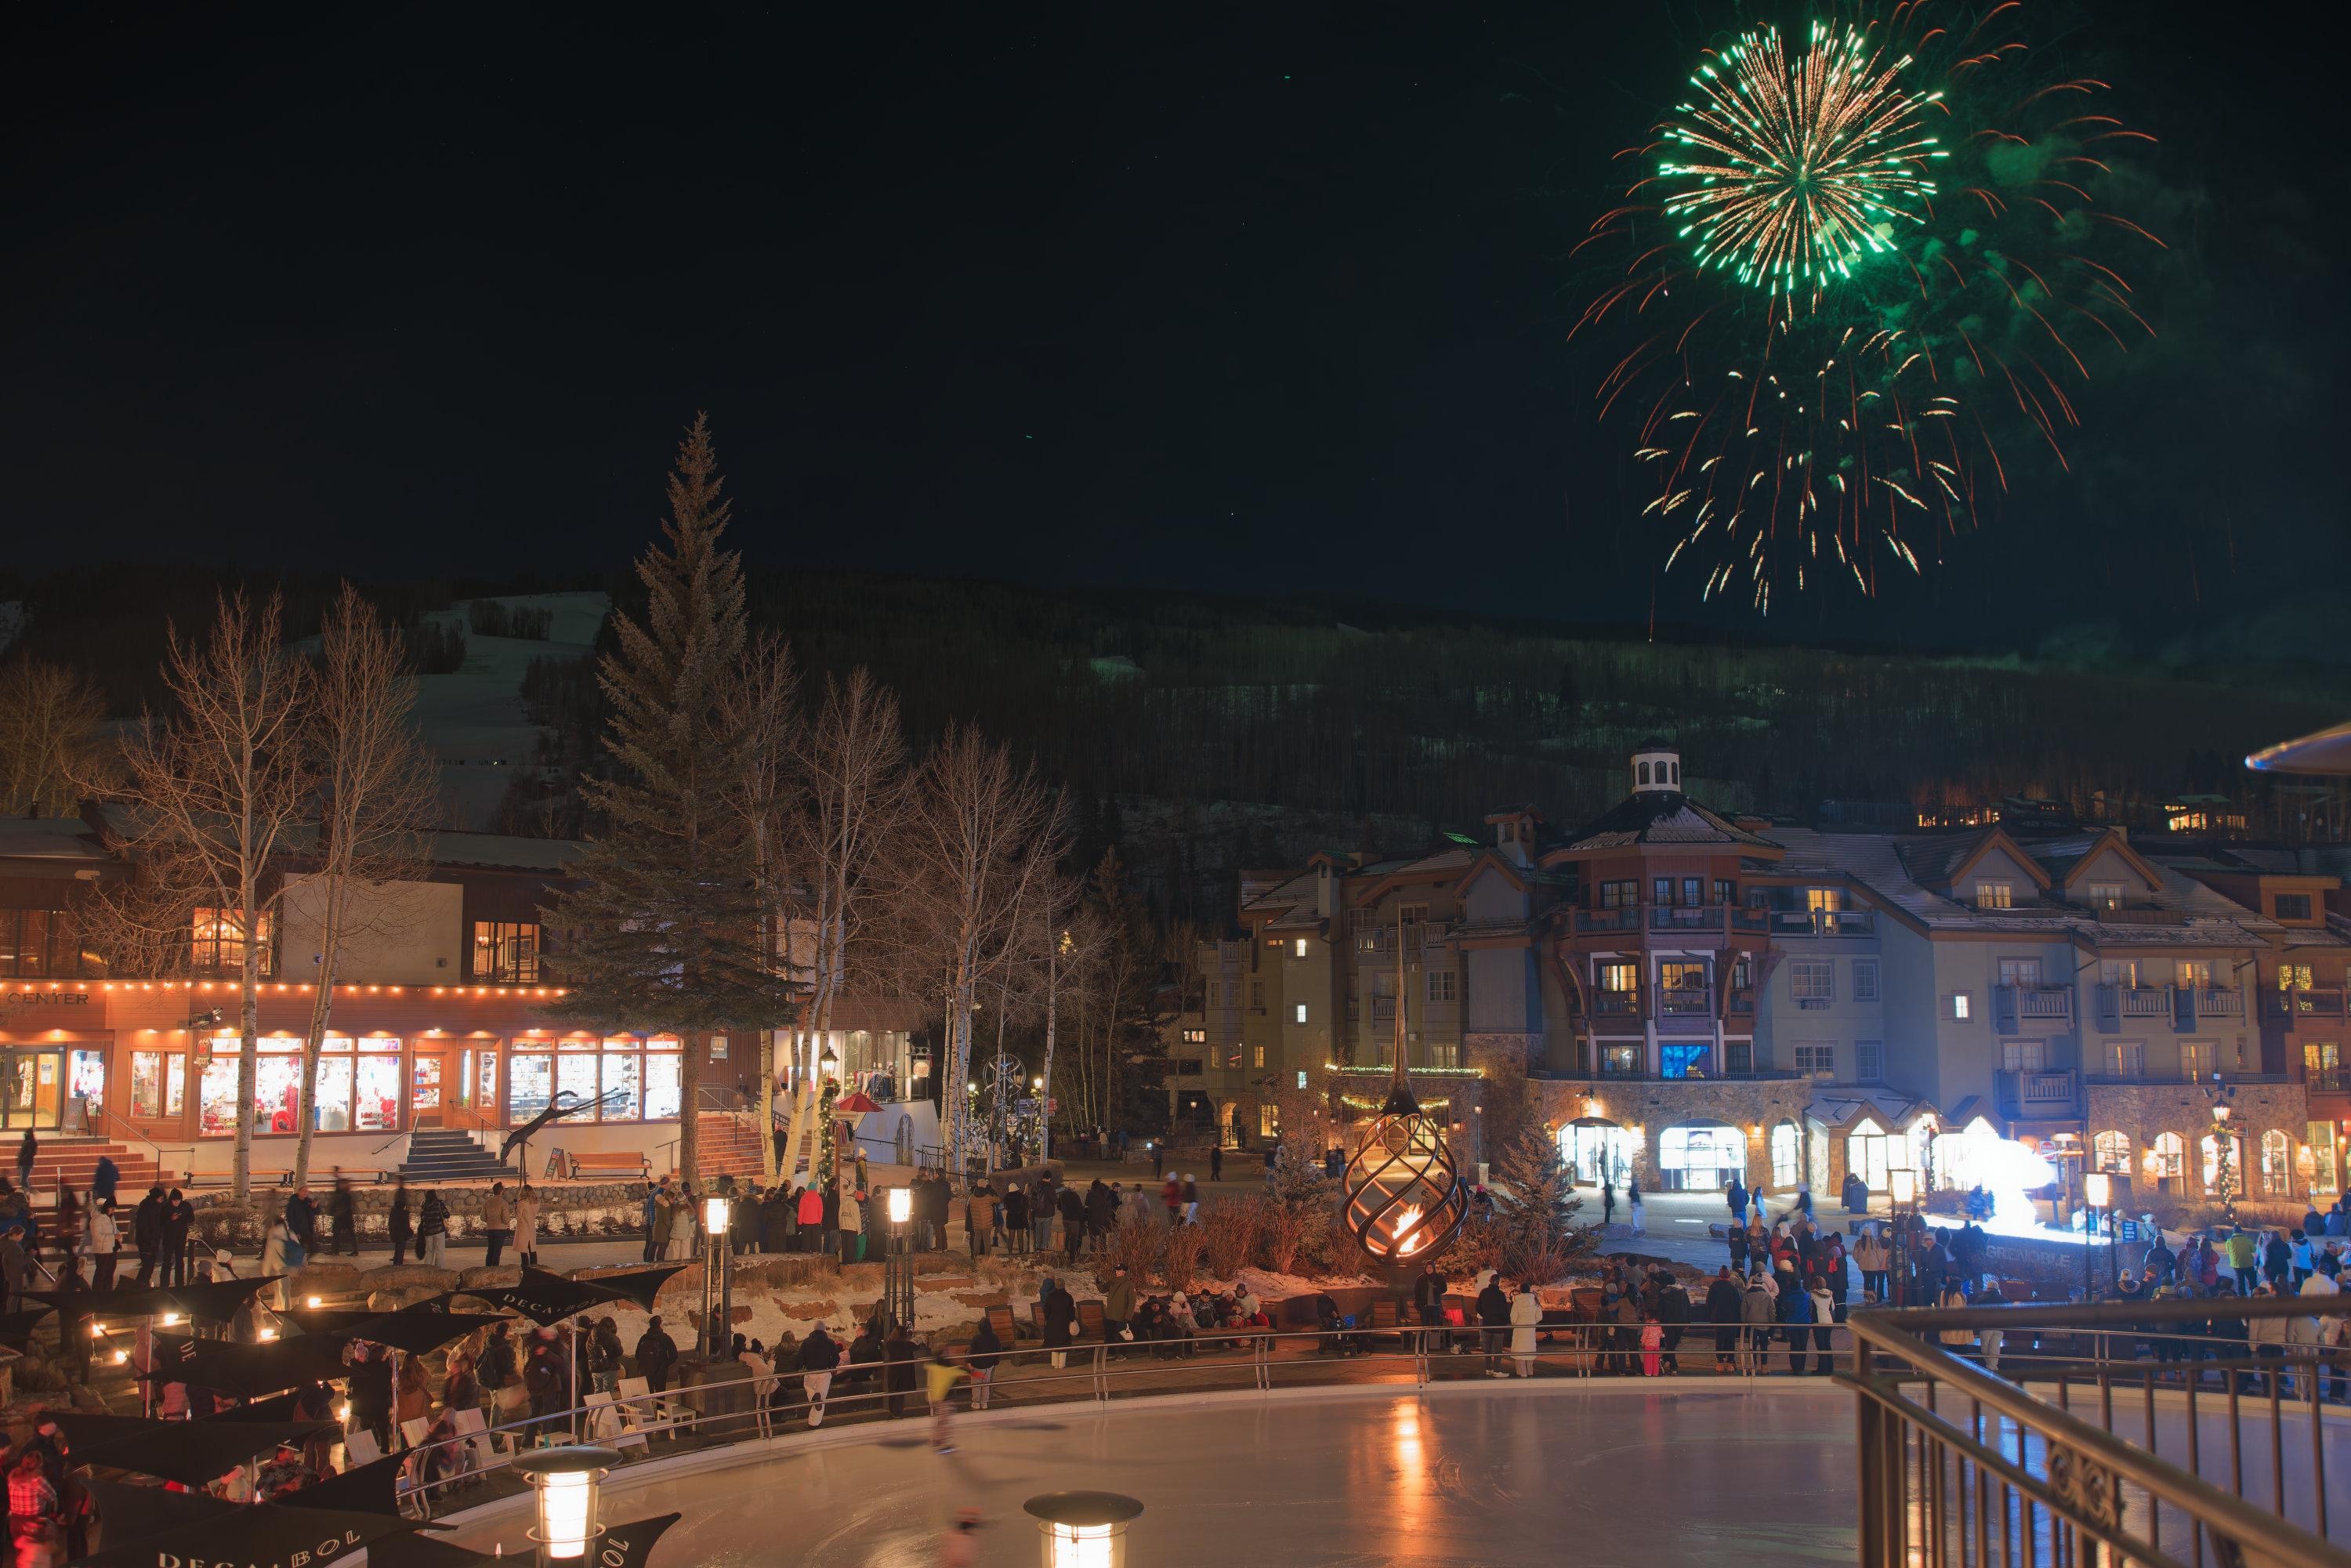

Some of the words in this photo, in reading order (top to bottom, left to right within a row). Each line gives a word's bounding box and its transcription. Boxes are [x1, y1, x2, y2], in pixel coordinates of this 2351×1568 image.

[7, 992, 89, 1005] CENTER
[503, 1294, 552, 1314] DECA
[179, 1340, 197, 1362] DE
